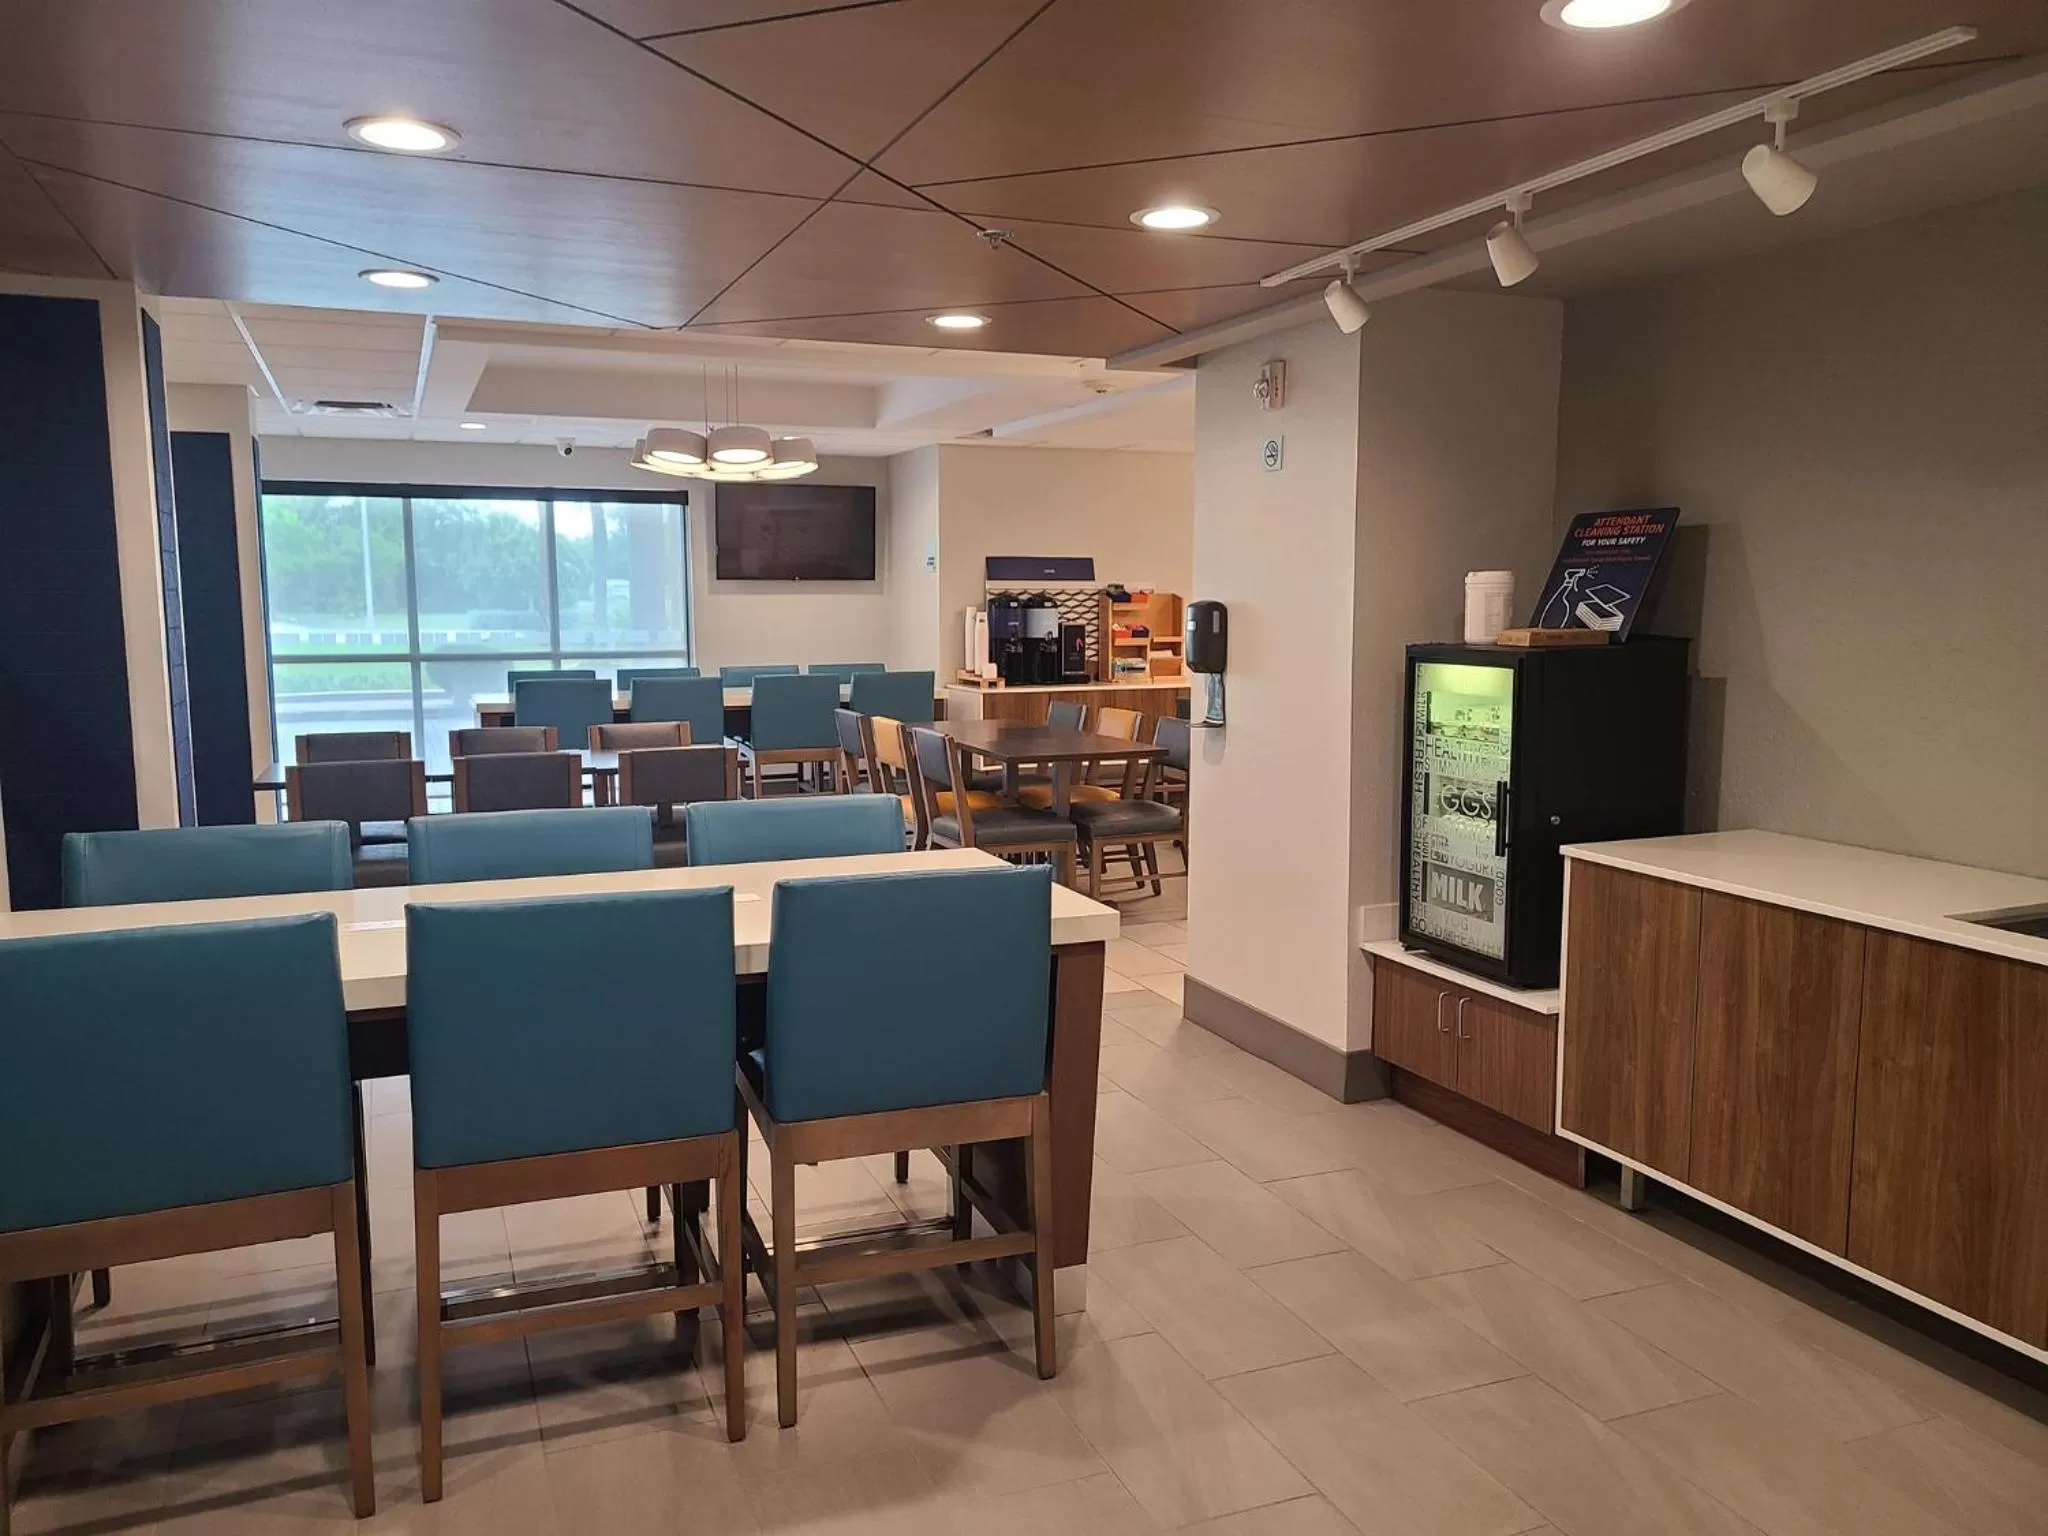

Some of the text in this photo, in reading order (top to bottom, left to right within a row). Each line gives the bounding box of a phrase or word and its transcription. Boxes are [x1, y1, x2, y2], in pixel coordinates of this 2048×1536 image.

[1574, 523, 1665, 538] CLEANING STATION
[1594, 515, 1651, 527] ATTENDANT
[1581, 536, 1646, 547] FOR YOUR SAFETY
[1414, 739, 1425, 793] FRESH
[1431, 784, 1493, 819] GGS
[1411, 841, 1421, 902] HEALTHY
[1431, 871, 1484, 913] MILK
